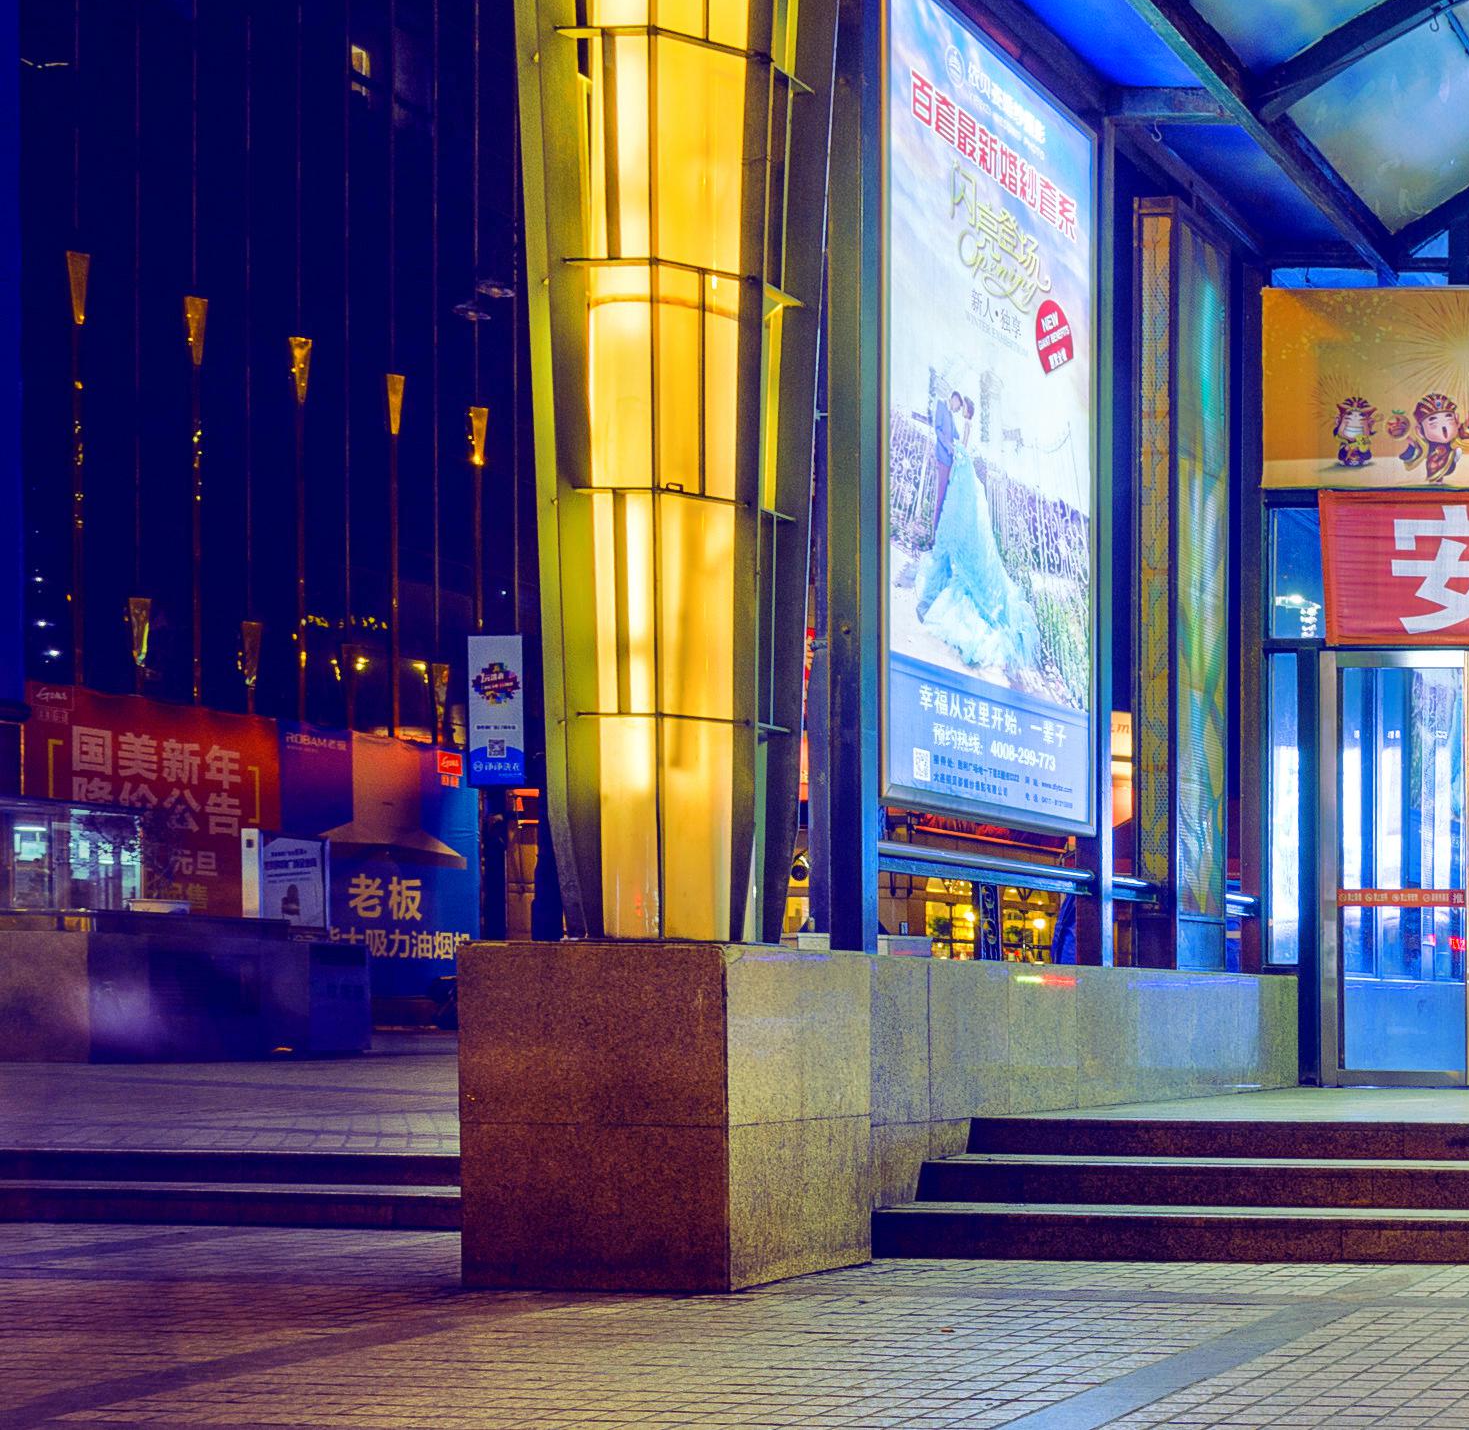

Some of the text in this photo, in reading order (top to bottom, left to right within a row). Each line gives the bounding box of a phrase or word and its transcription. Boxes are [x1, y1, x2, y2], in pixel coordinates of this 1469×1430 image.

[910, 67, 1078, 243] 百套最新婚纱套系
[71, 725, 242, 790] 国美新年
[990, 740, 1056, 772] 4008-299-773
[347, 873, 424, 922] 老板
